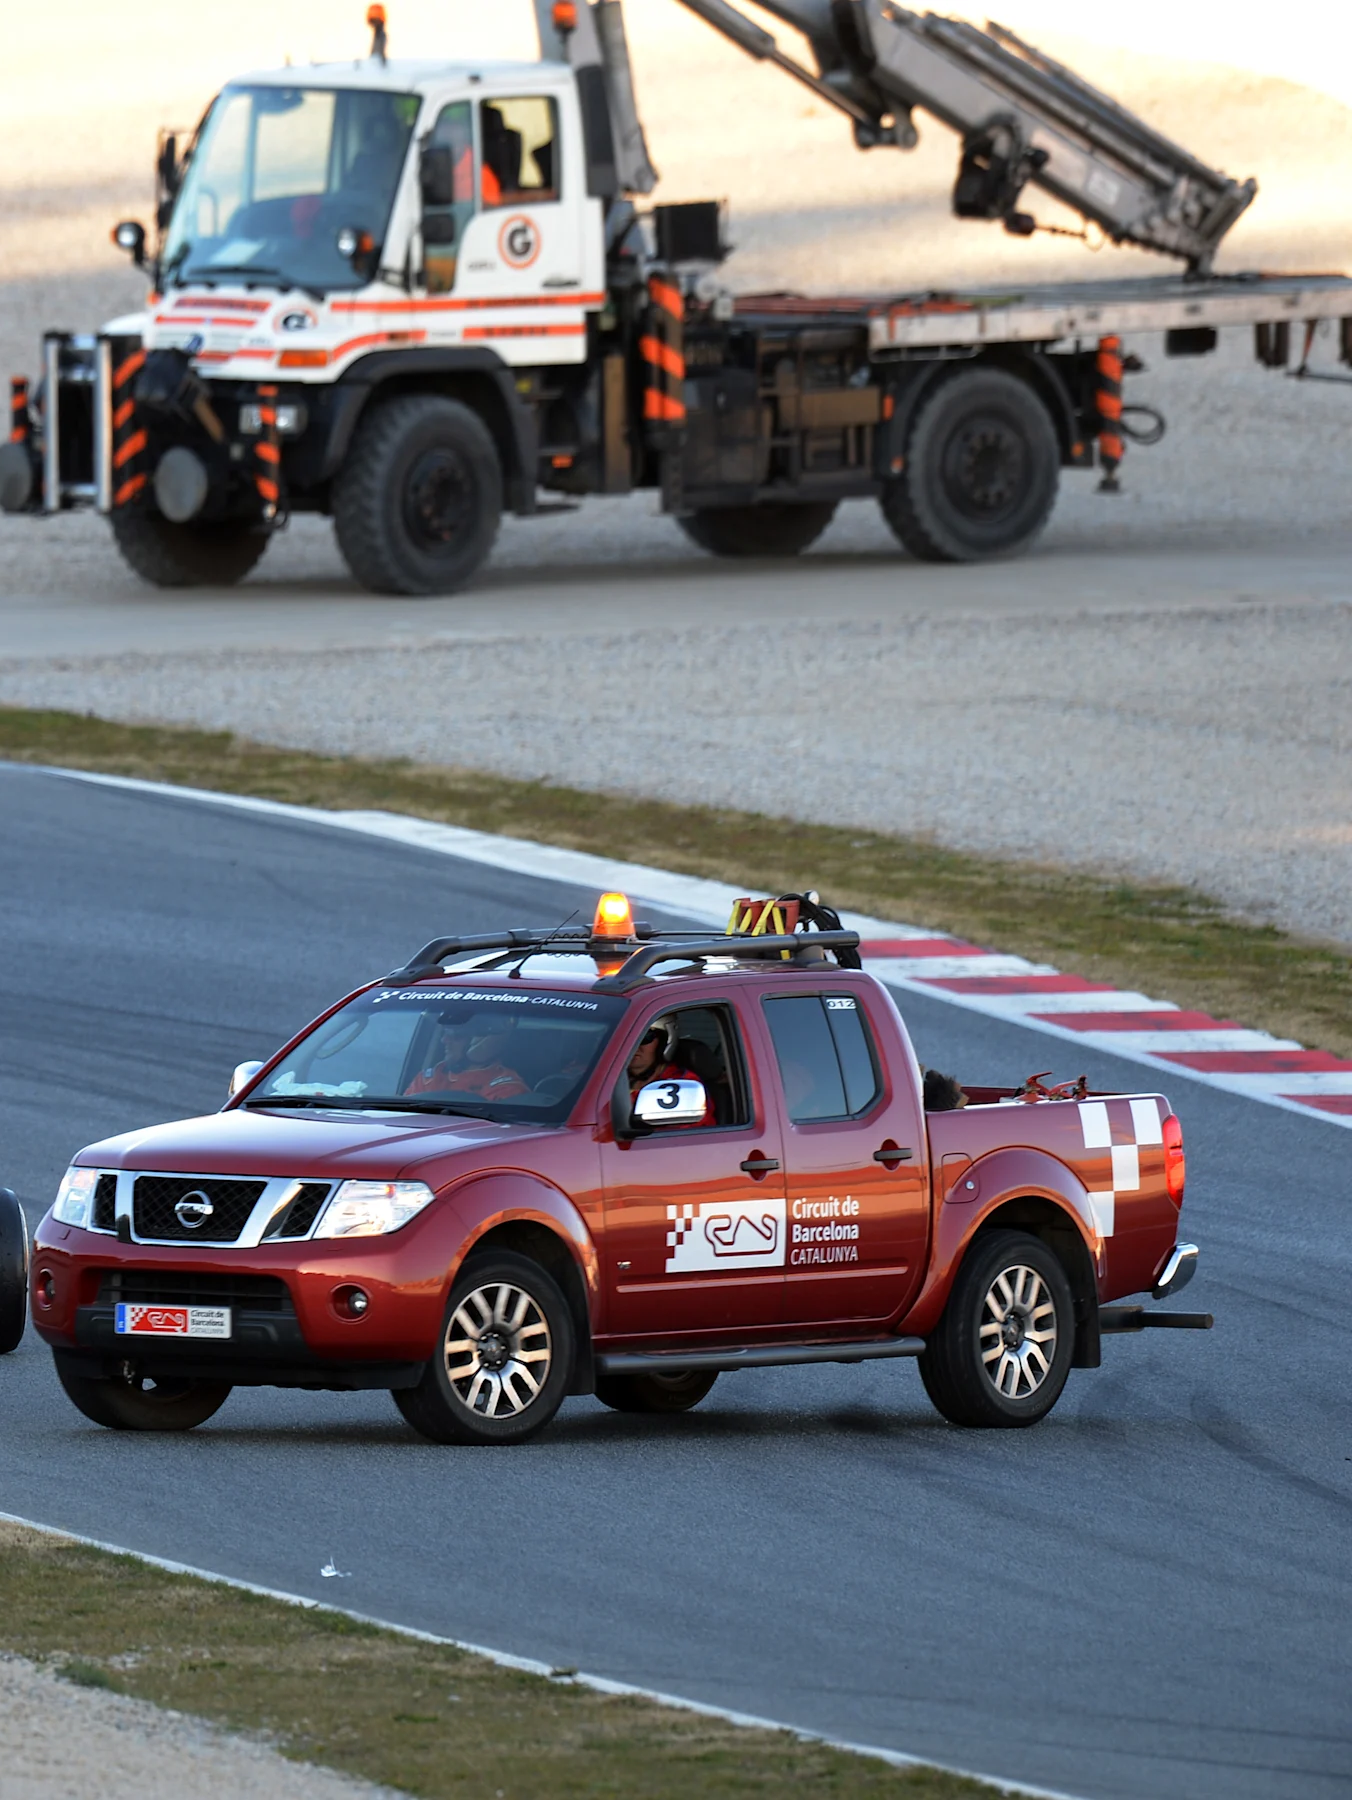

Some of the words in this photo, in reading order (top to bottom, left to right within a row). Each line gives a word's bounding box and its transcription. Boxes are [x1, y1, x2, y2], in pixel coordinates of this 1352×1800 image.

[399, 991, 445, 1000] Circuit
[444, 992, 463, 1000] de
[656, 1082, 682, 1110] 3
[792, 1196, 840, 1219] Circuit
[842, 1195, 859, 1217] de
[792, 1221, 859, 1243] Barcelona
[790, 1245, 859, 1265] CATALUNYA
